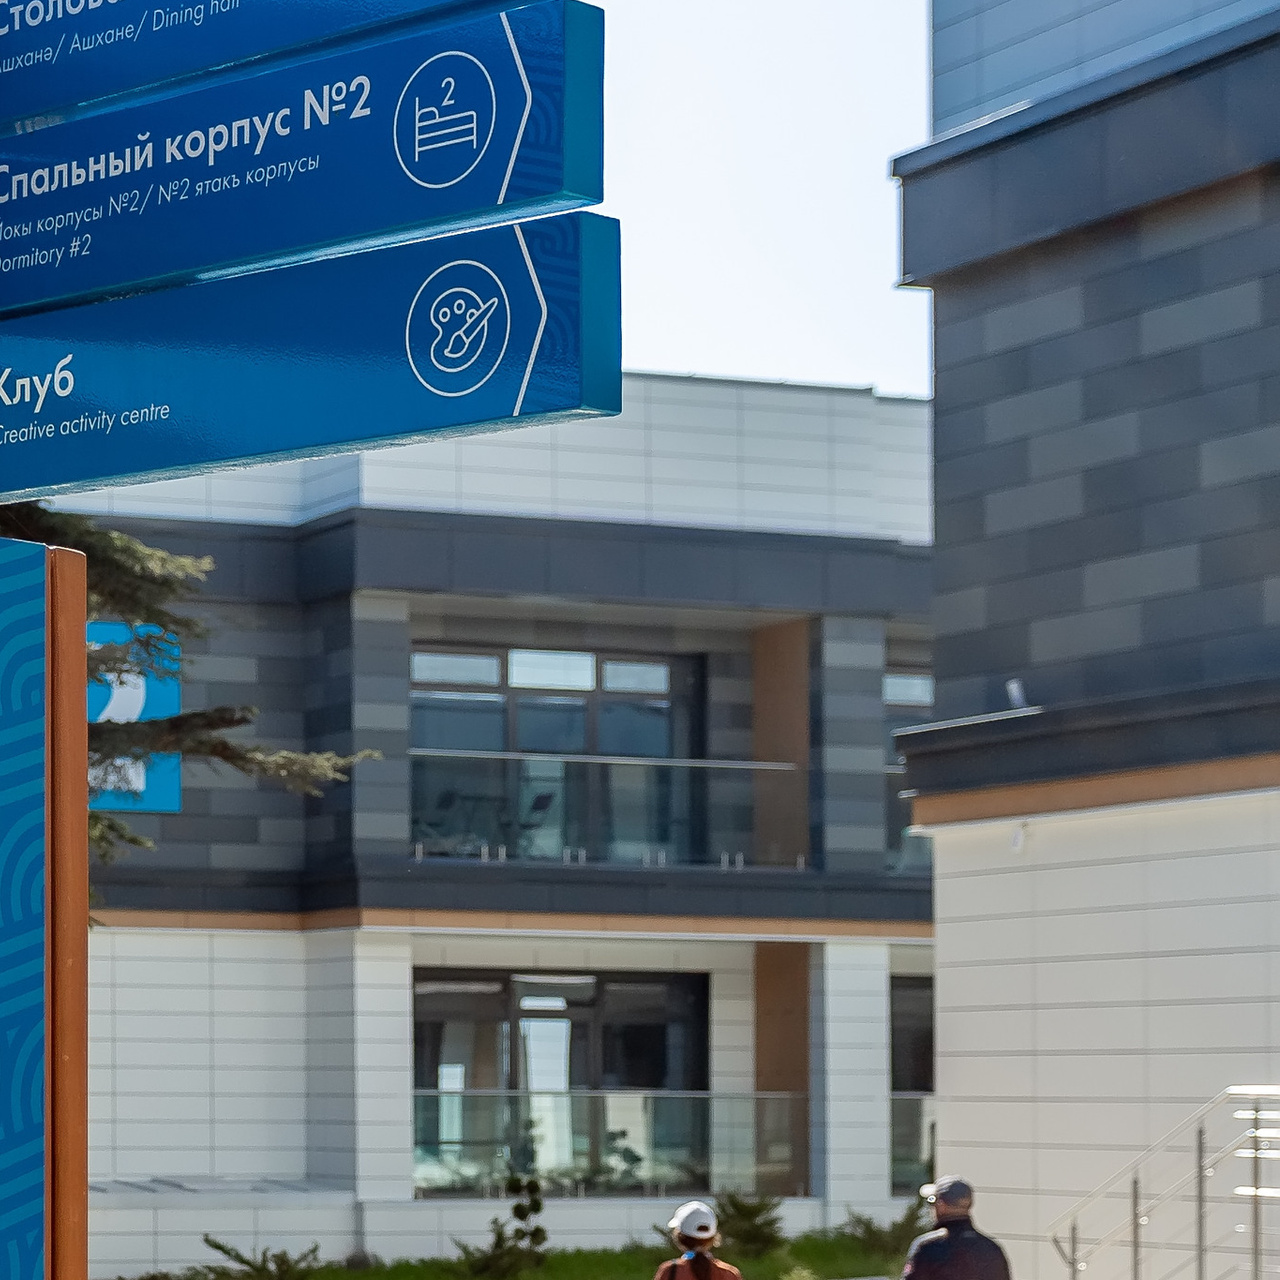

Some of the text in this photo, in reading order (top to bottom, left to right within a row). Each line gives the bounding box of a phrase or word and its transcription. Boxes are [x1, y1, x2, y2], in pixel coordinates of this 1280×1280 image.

[69, 10, 148, 54] Ашхане/
[152, 4, 205, 32] Dining
[441, 77, 456, 106] 2
[165, 107, 291, 166] корпус
[304, 75, 372, 130] №2
[36, 204, 103, 236] корпусы
[108, 183, 154, 216] №2/
[158, 178, 189, 205] №2
[195, 173, 241, 197] ятакъ
[245, 154, 320, 187] корпусы
[69, 233, 92, 258] #2
[60, 410, 117, 435] activity
[120, 402, 170, 426] centre
